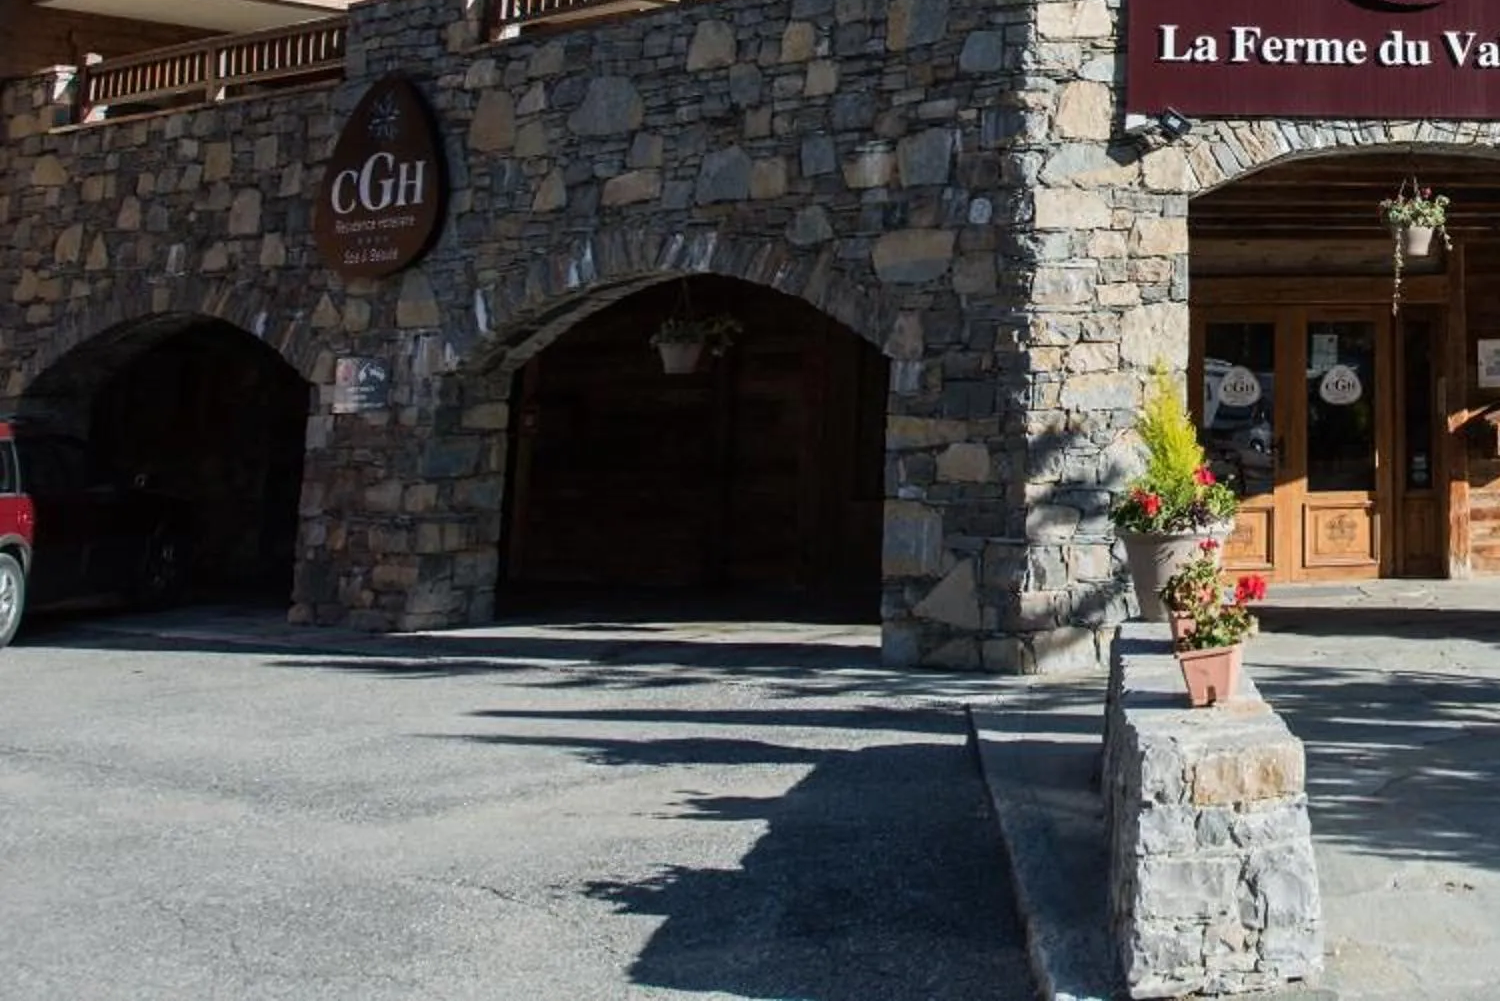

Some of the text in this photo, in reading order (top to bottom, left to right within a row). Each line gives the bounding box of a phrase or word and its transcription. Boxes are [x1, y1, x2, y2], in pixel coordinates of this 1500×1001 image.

[1159, 24, 1218, 64] La
[1231, 26, 1367, 66] Ferme
[1379, 31, 1432, 66] du
[331, 151, 426, 214] CGH
